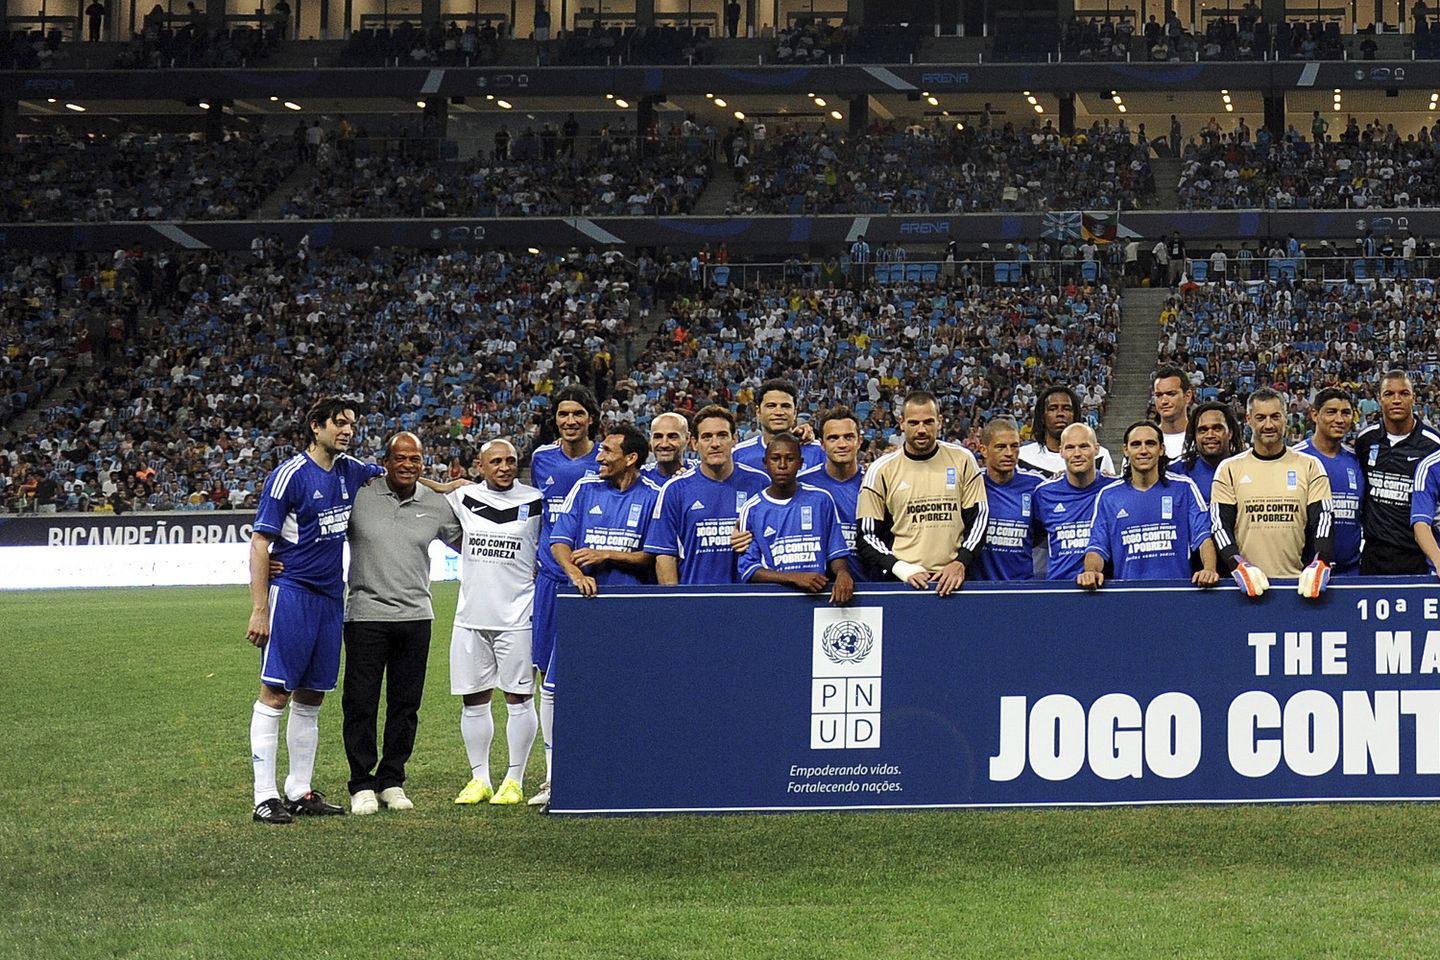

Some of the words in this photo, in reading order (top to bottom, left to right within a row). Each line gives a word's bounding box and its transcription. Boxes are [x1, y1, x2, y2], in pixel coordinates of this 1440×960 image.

[922, 73, 969, 84] ARENA
[899, 223, 950, 234] ARENA
[907, 504, 926, 515] JOGO
[1245, 504, 1264, 514] JOGO
[1266, 504, 1300, 513] CONTRA
[912, 514, 918, 524] A
[919, 512, 953, 523] PBREZA
[1257, 513, 1295, 523] POBREZA
[49, 521, 184, 546] BICAMPEÃO
[487, 539, 521, 551] CONTRA
[477, 548, 516, 560] POBREZA
[1247, 631, 1348, 676] THE
[988, 692, 1202, 782] JOGO
[789, 764, 867, 778] Empoderando
[870, 763, 902, 775] vidas.
[787, 781, 860, 793] Fortalecendo
[861, 780, 903, 795] nações.
